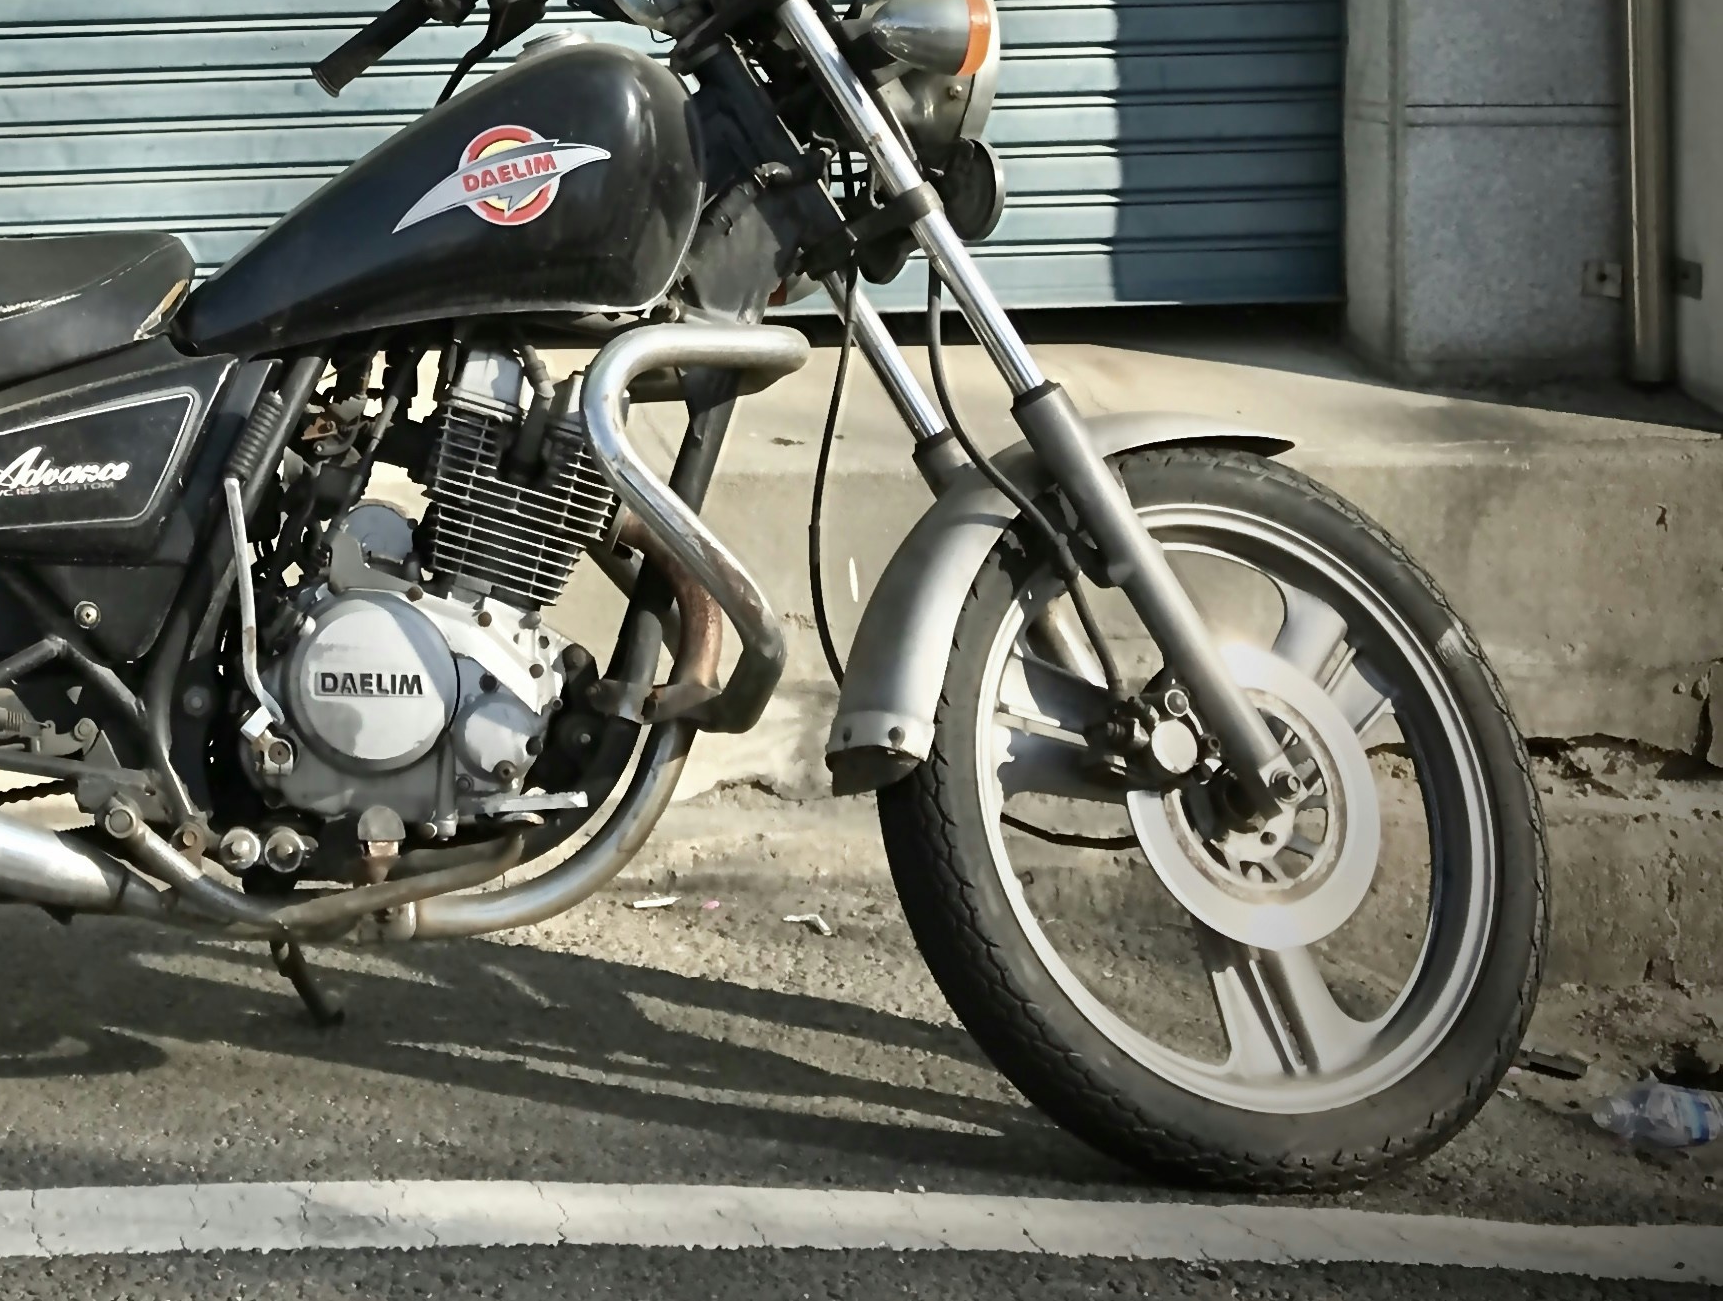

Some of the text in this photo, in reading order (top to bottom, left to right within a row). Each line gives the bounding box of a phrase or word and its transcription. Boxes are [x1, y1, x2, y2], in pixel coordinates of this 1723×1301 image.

[462, 153, 557, 192] DAELIM
[16, 486, 41, 496] 125
[47, 481, 115, 493] CUSTOM
[320, 671, 424, 696] DAELIM
